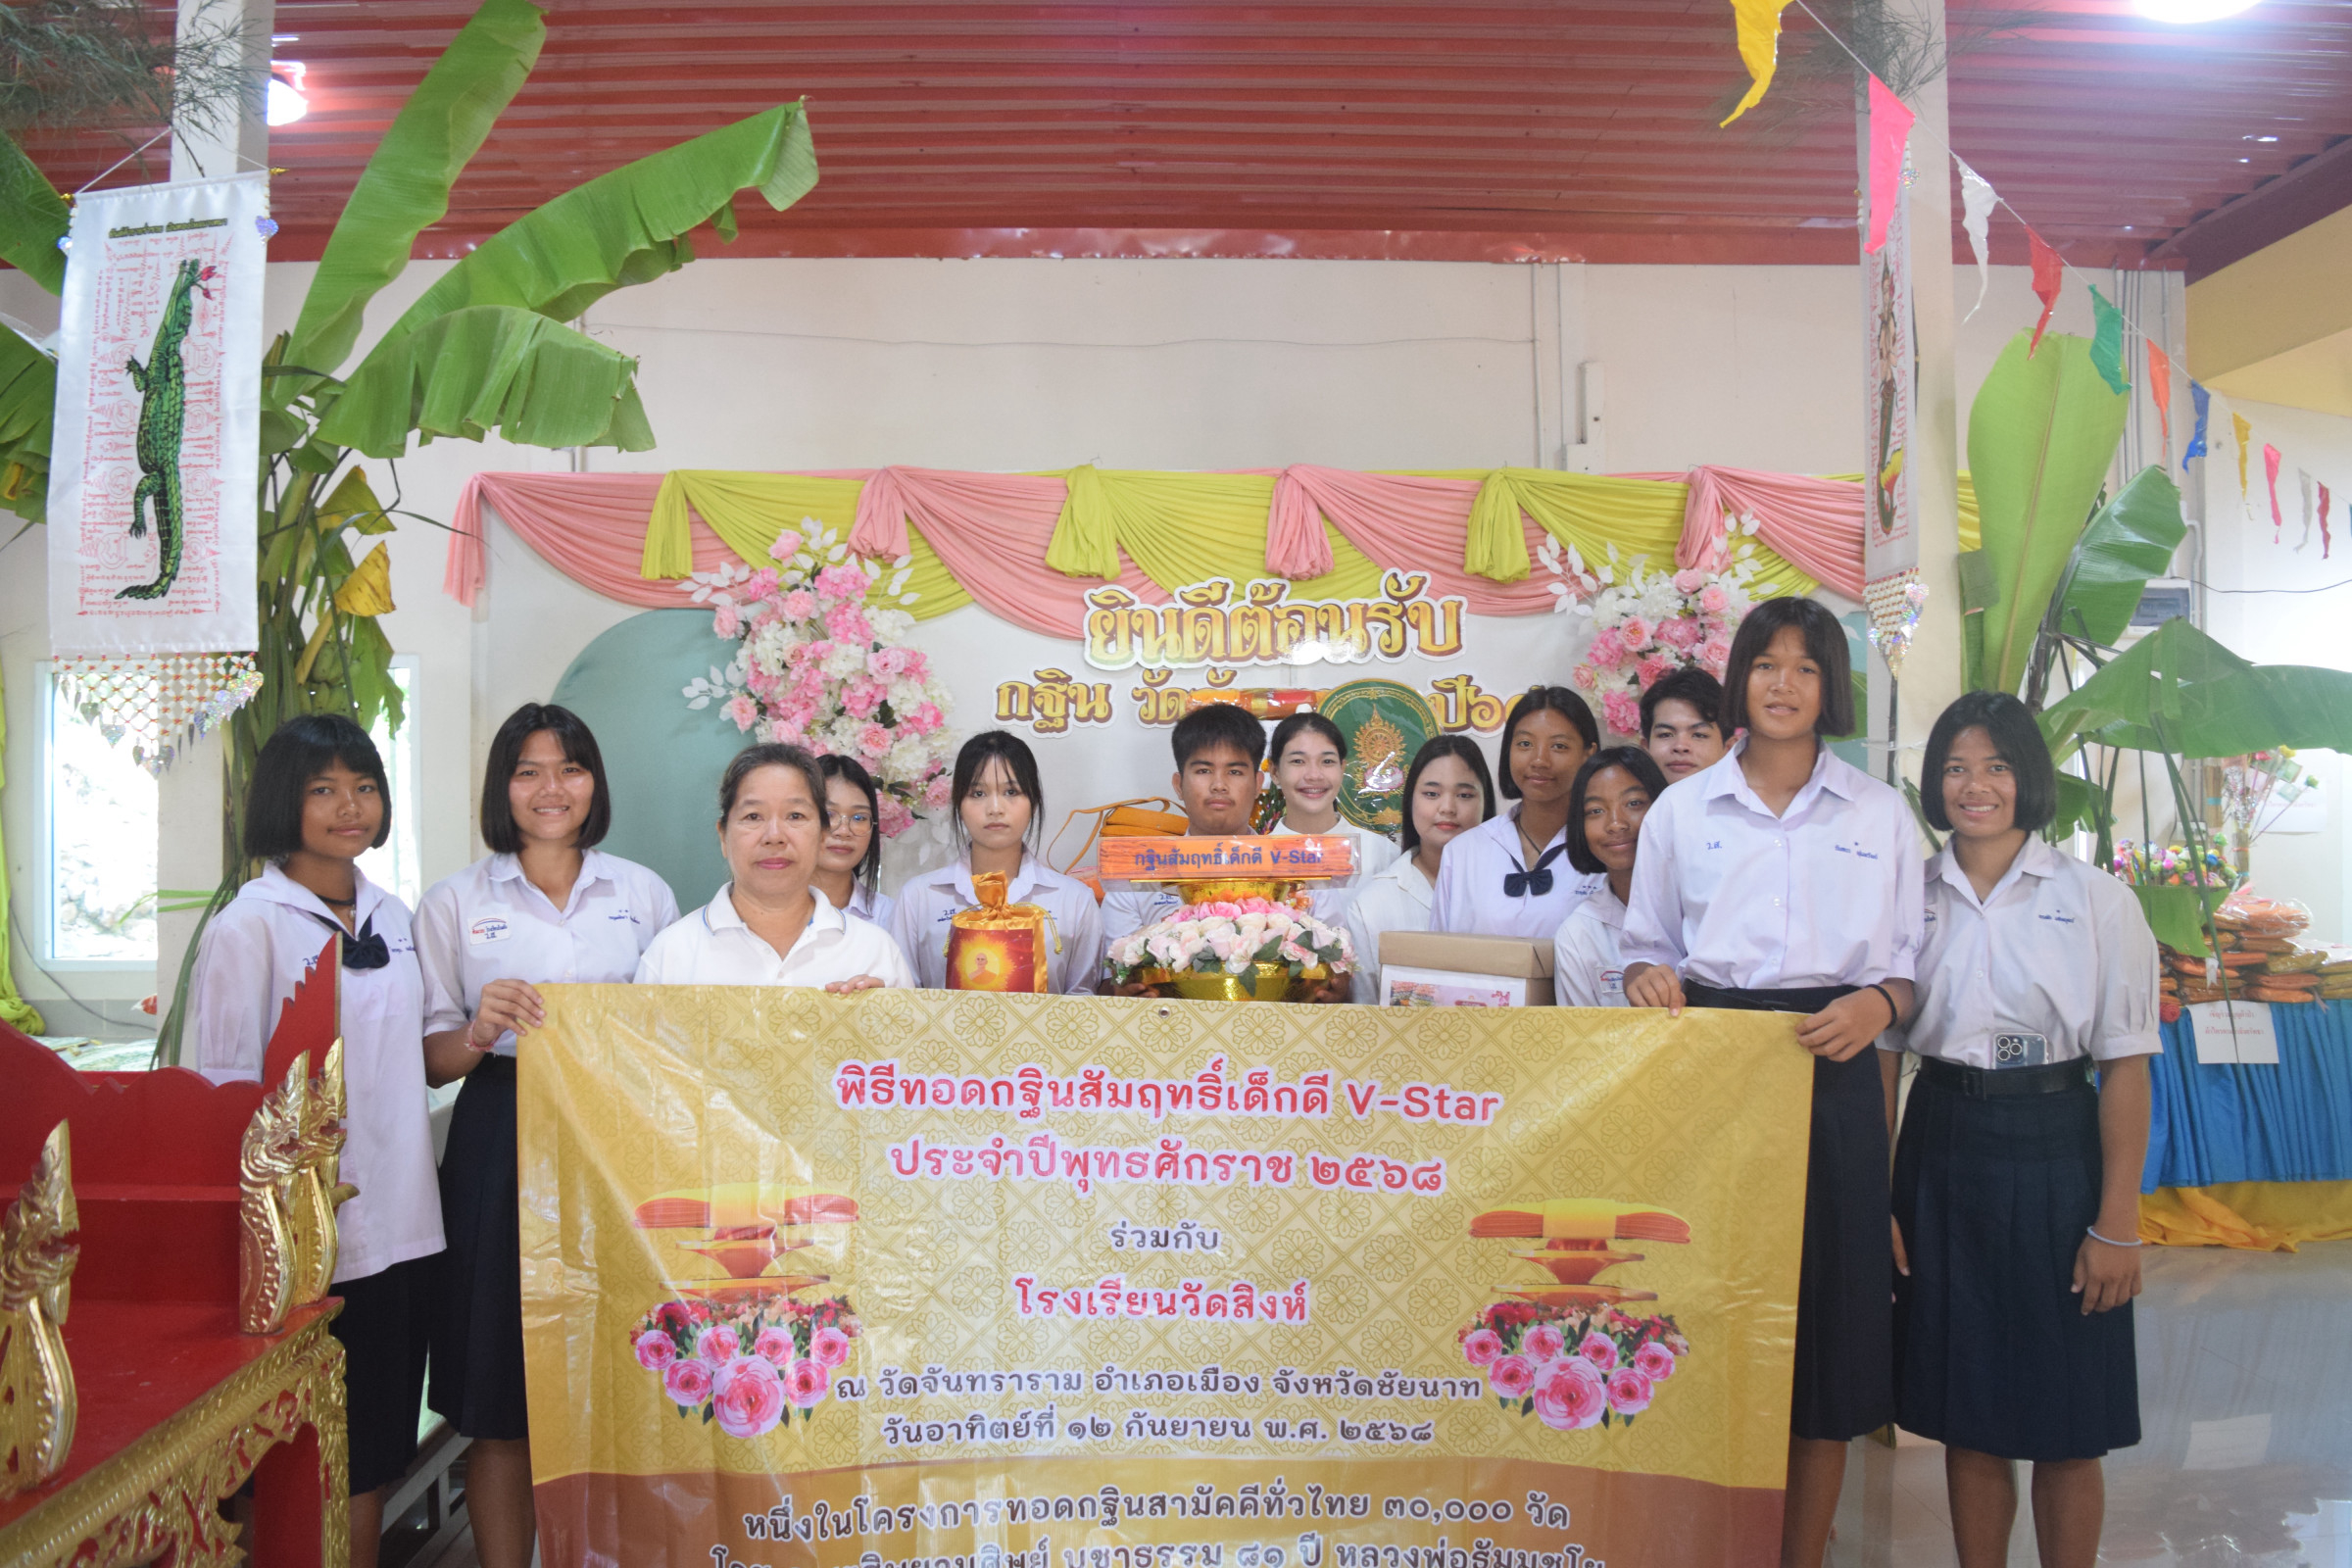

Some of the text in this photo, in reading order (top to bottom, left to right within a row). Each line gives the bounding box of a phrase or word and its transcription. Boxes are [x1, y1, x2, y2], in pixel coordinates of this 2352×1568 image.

[1088, 570, 1464, 662] ยินดีต้อนรับ
[996, 668, 1111, 733] กฐิน
[837, 1058, 1498, 1122] พิธีทอดกฐินสัมฤทธิ์เด็กดี V-Star
[891, 1134, 1443, 1193] ประจำปีพุทธศักราช ๒๕๖๘
[1110, 1221, 1219, 1250] ร่วมกับ
[1015, 1277, 1306, 1321] โรงเรียนวัดสิงห์
[837, 1365, 1481, 1398] ณ วัดจันทราราม อำเภอเมือง จังหวัดชัยนาท
[884, 1404, 1432, 1445] วันอาทิตย์ที่ ๑๒ กันยายน พ.ศ. ๒๕๖๘
[745, 1477, 1568, 1540] หนึ่งในโครงการทอดกฐินสามัคคีทั่วไทย ๓๐,๐๐๐ วัด
[1238, 1542, 1285, 1568] ๘๑
[1298, 1532, 1322, 1567] ปี
